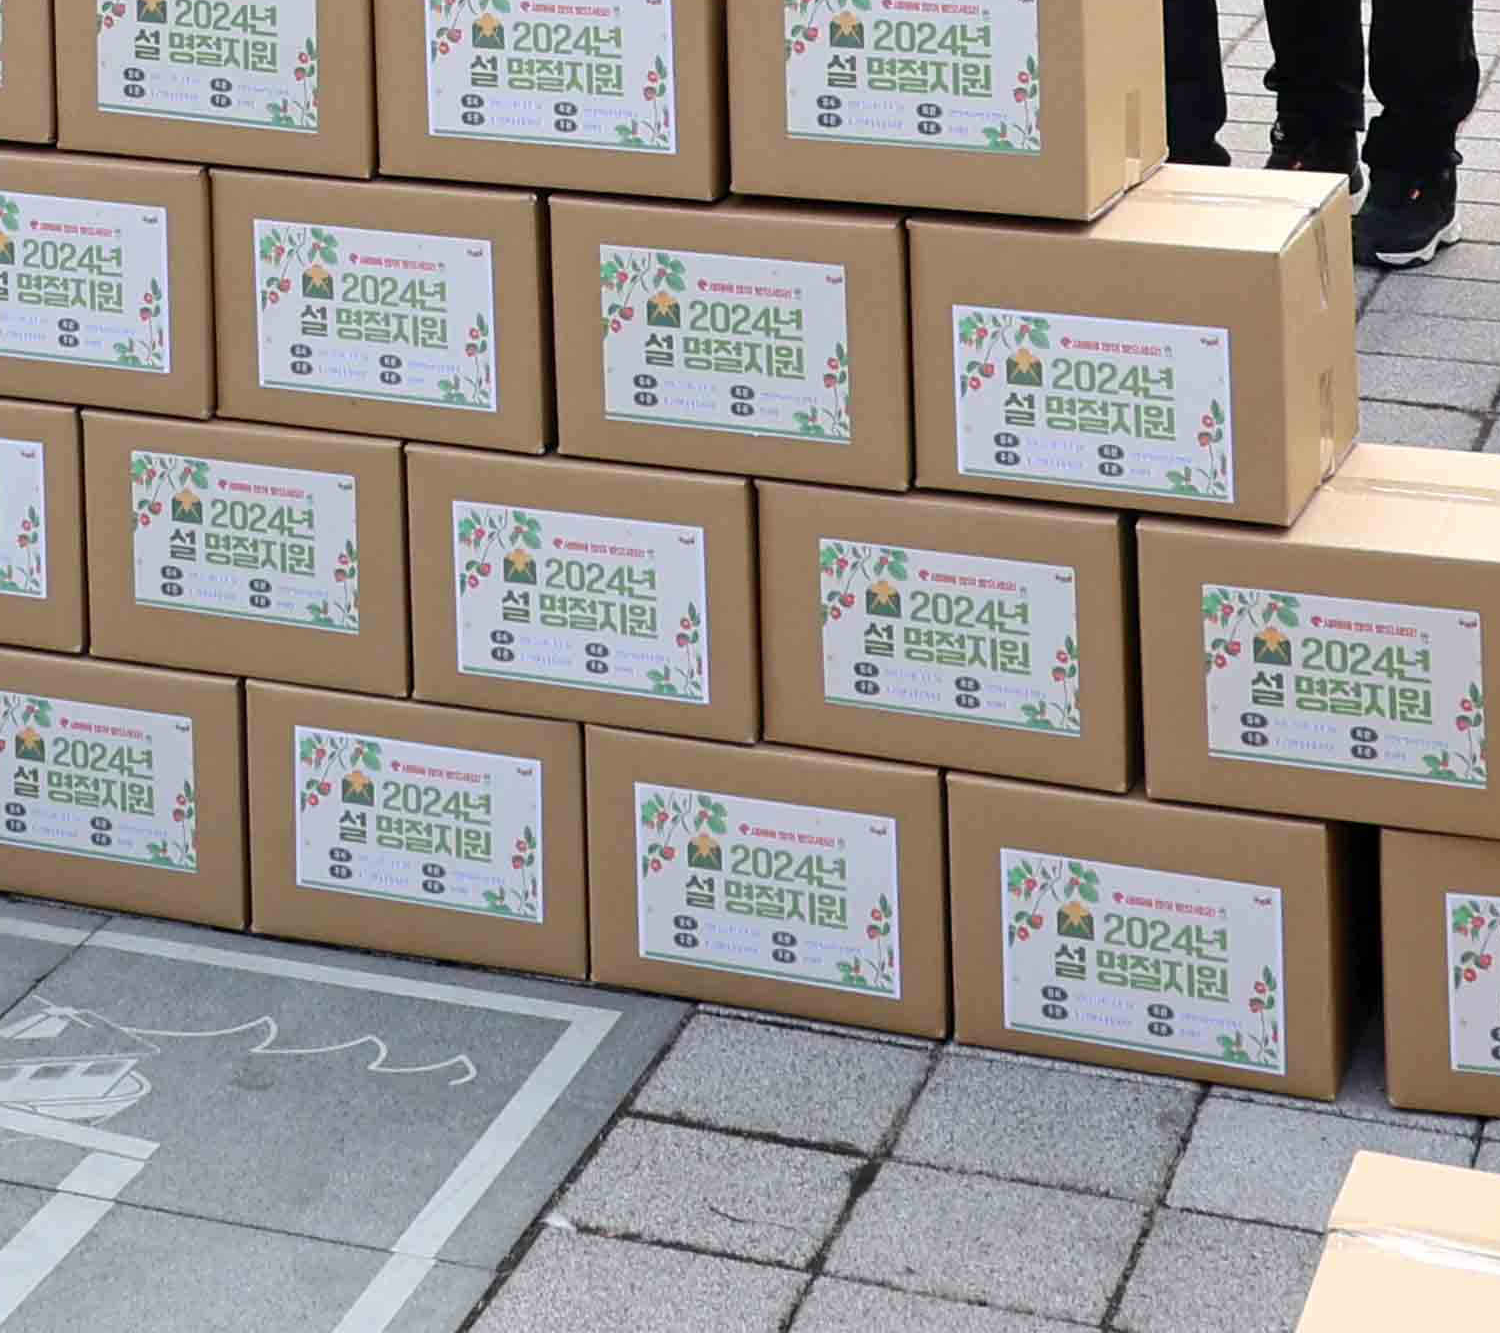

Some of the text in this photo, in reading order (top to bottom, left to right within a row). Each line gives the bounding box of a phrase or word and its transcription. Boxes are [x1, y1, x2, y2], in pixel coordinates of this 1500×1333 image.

[133, 28, 277, 73] 설 명절지원
[512, 21, 622, 58] 2024년
[873, 19, 991, 58] 2024년
[470, 54, 624, 95] 설 명절지원
[827, 53, 992, 97] 설 명절지원
[22, 238, 122, 277] 2024년
[16, 272, 123, 313] 명절지원
[341, 272, 446, 312] 2024년
[300, 304, 447, 349] 설 명절지원
[689, 300, 803, 341] 2024년
[644, 332, 804, 380] 설 명절지원
[1051, 358, 1174, 401] 2024년
[1004, 391, 1176, 440] 설 명절지원
[544, 557, 656, 601] 2024년
[501, 589, 657, 639] 설 명절지원
[910, 590, 1029, 636] 2024년
[864, 621, 1030, 674] 설 명절지원
[1301, 637, 1431, 683] 2024년
[1252, 670, 1432, 723] 설 명절지원
[52, 737, 154, 780] 2024년
[13, 765, 154, 815] 설 명절지원
[382, 780, 492, 825] 2024년
[339, 809, 492, 862] 설 명절지원
[730, 844, 846, 891] 2024년
[684, 874, 847, 930] 설 명절지원
[1103, 912, 1228, 963] 2024년
[1054, 943, 1228, 1003] 설 명절지원
